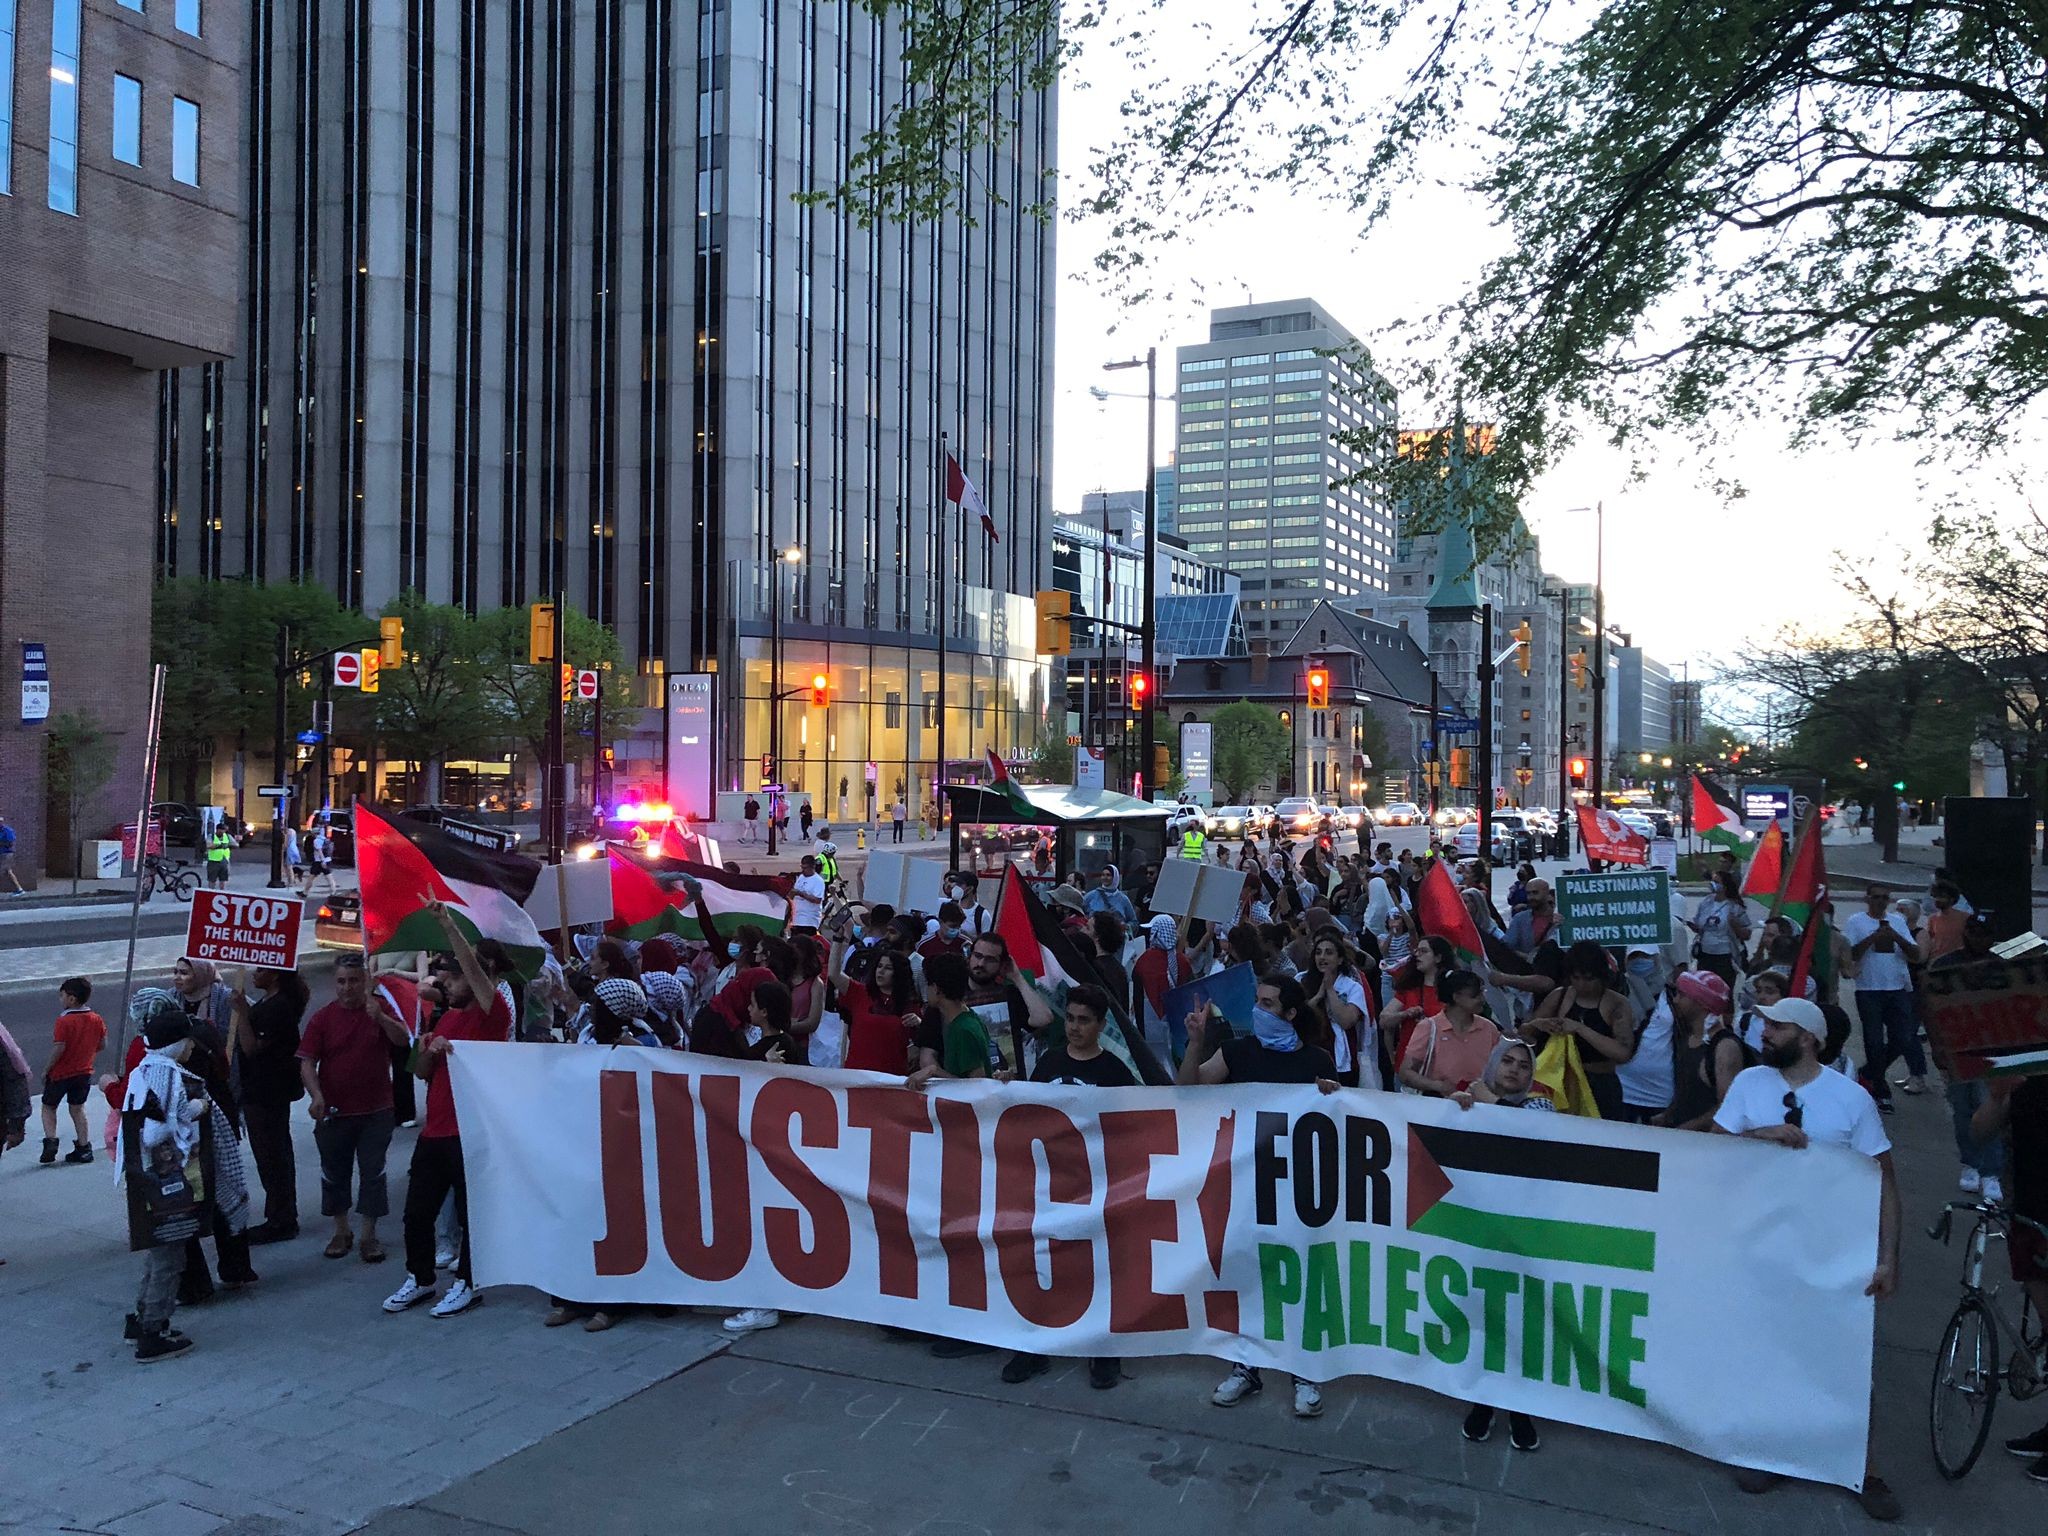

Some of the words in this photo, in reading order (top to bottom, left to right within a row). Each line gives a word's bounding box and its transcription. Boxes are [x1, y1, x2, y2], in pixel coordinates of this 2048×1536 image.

[1566, 876, 1657, 894] PALESTINIANS
[209, 894, 289, 931] STOP
[1571, 902, 1605, 918] HAVE
[1607, 900, 1656, 916] HUMAN
[204, 925, 231, 941] THE
[233, 928, 286, 948] KILLING
[1572, 925, 1621, 941] RIGHTS
[1622, 923, 1658, 939] TOO!!
[199, 943, 217, 958] OF
[219, 945, 286, 966] CHILDREN
[1254, 1111, 1392, 1228] FOR
[593, 1069, 1240, 1335] JUSTICE!
[1259, 1240, 1650, 1408] PALESTINE
